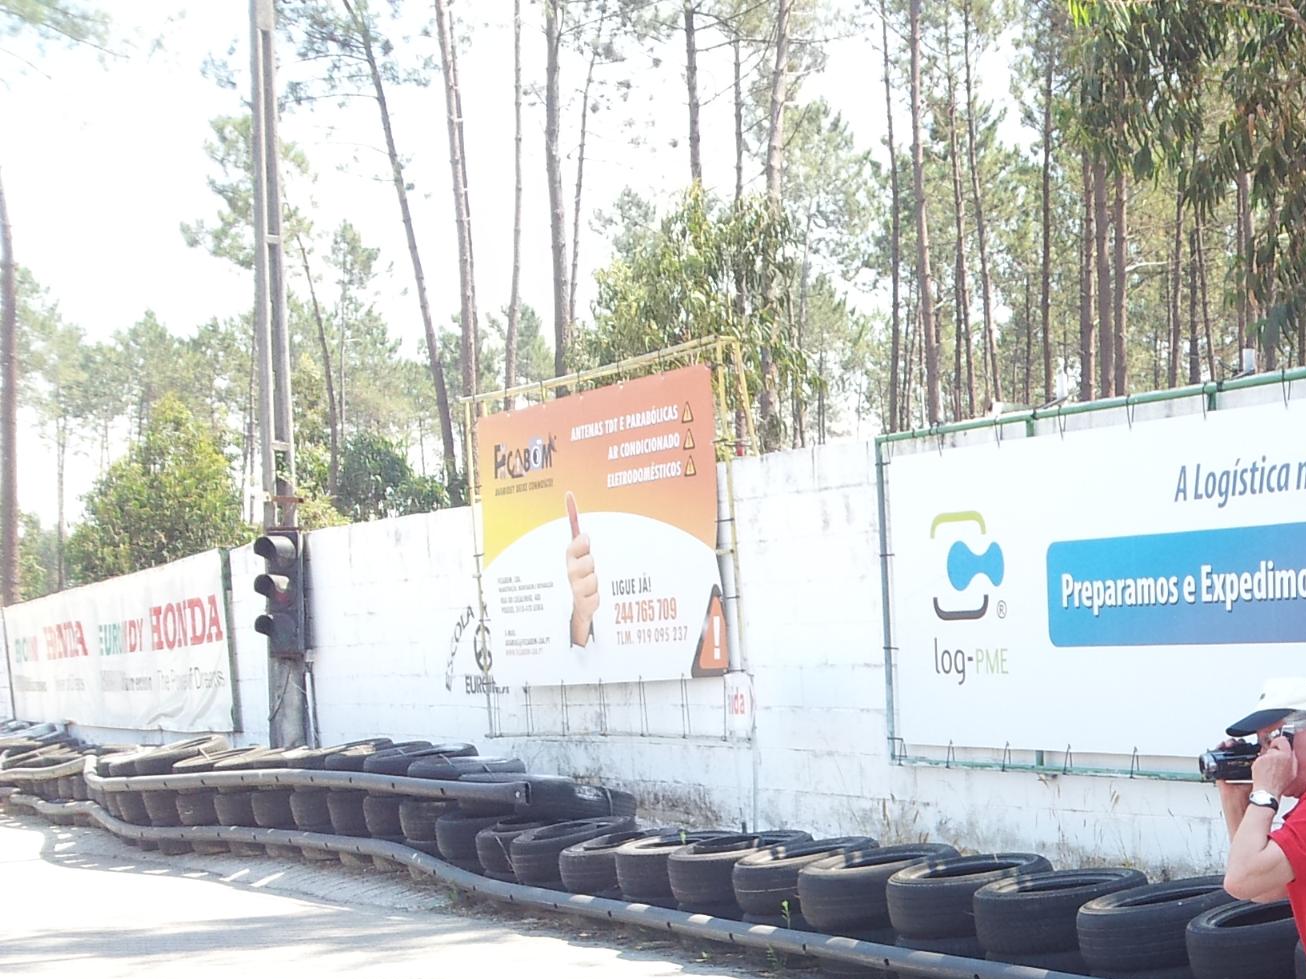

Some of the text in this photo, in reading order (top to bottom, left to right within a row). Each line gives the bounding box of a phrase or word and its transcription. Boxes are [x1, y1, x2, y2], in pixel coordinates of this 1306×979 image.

[571, 405, 679, 441] ANTENAS TDT E PARABÓLICAS
[608, 433, 680, 460] AR CONDICIONADO
[607, 461, 681, 488] ELETRODOMÉSTICOS
[1175, 465, 1188, 502] A
[1194, 456, 1291, 508] Logística
[612, 578, 636, 596] LIGUE
[1061, 573, 1178, 616] Preparamos
[1183, 574, 1196, 604] e
[149, 592, 224, 651] HONDA
[614, 597, 678, 625] 244 765 709
[637, 629, 651, 644] 919
[655, 627, 670, 643] 095
[673, 625, 688, 642] 237
[934, 636, 1009, 685] log-PME
